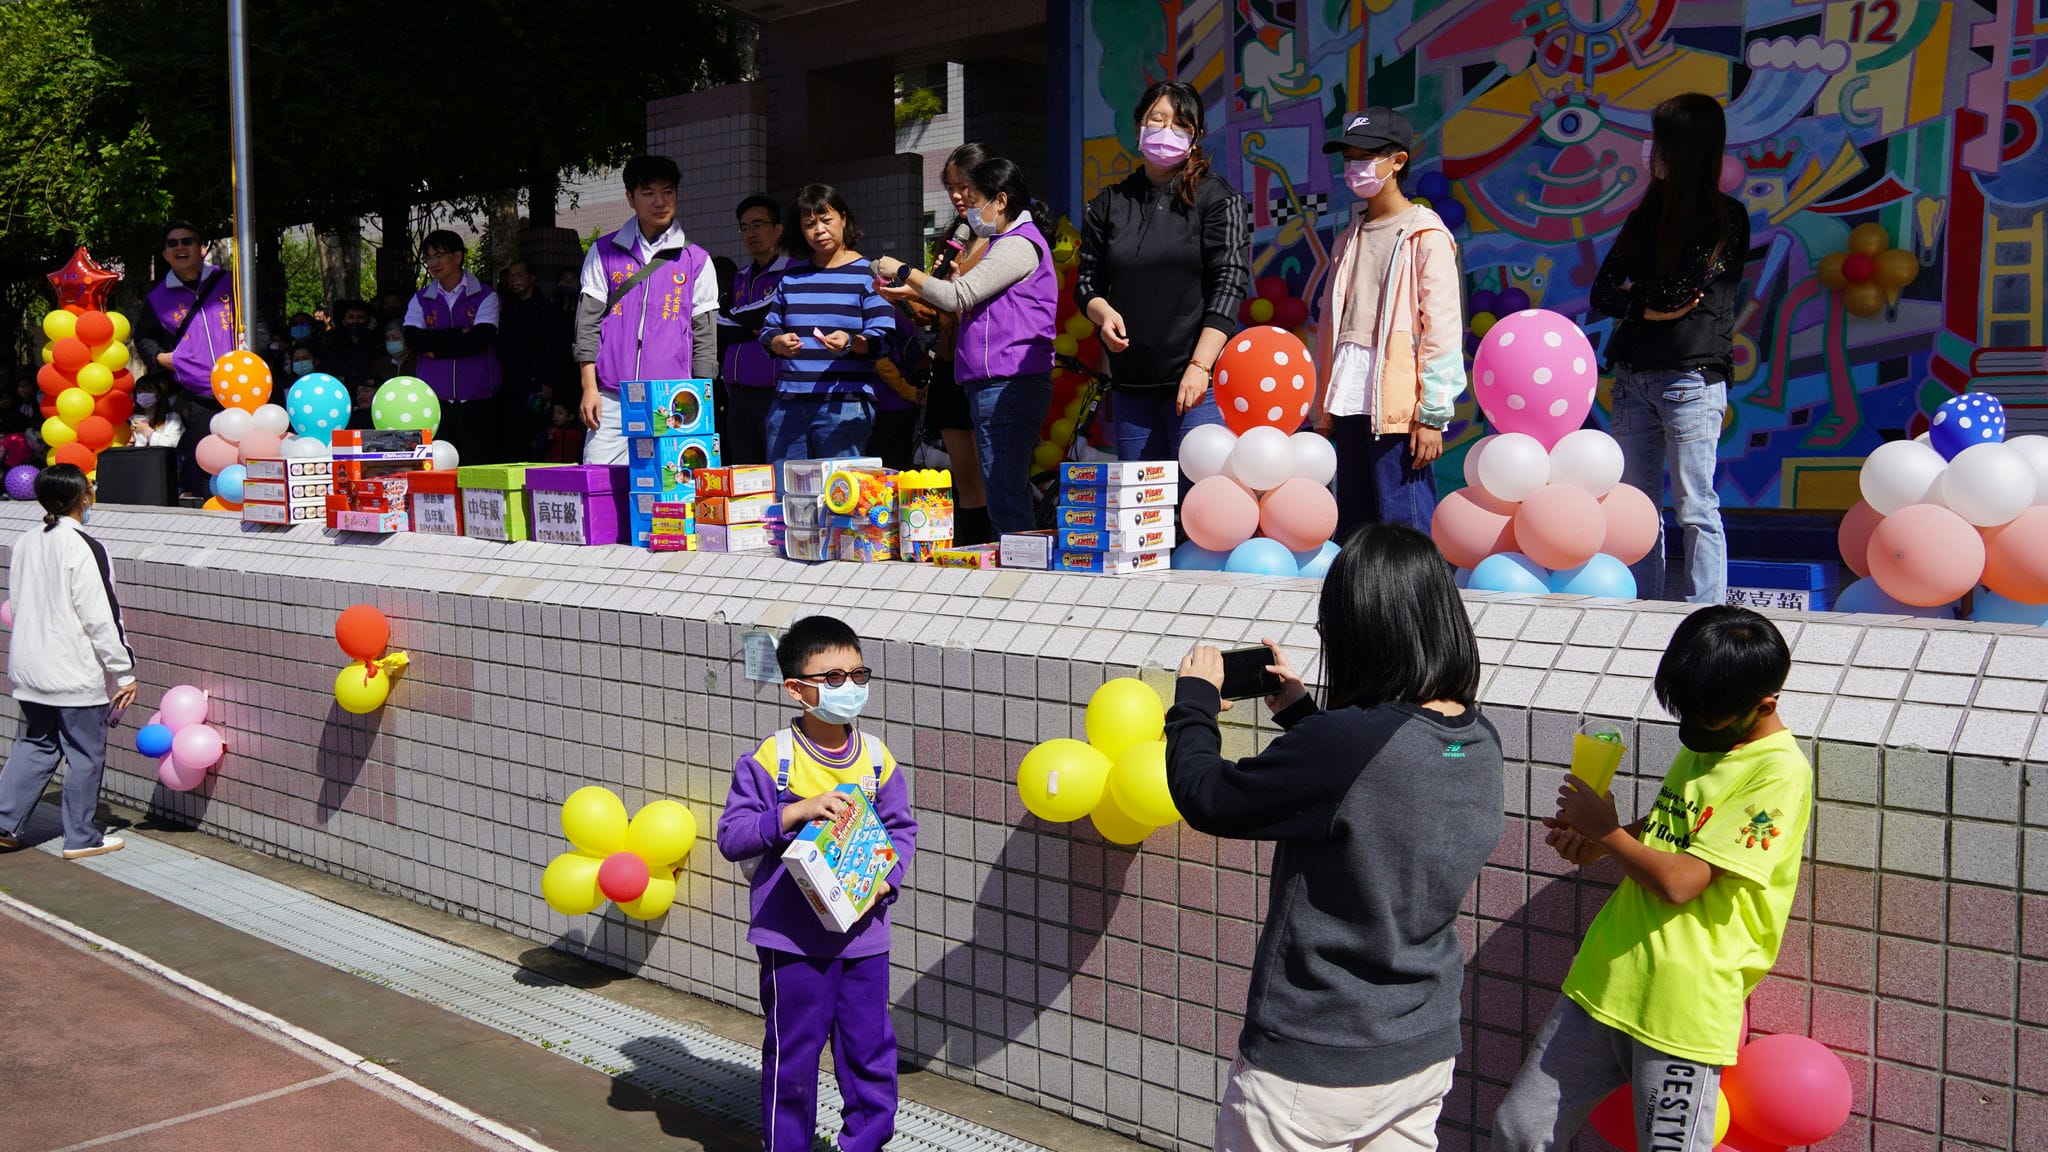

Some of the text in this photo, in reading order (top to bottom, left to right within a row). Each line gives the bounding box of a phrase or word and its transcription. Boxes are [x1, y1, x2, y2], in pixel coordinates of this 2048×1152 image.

[1849, 0, 1902, 44] 12
[1511, 0, 1677, 87] HOPE
[416, 446, 427, 458] 7
[468, 498, 501, 521] 中年級
[538, 501, 578, 525] 高年級
